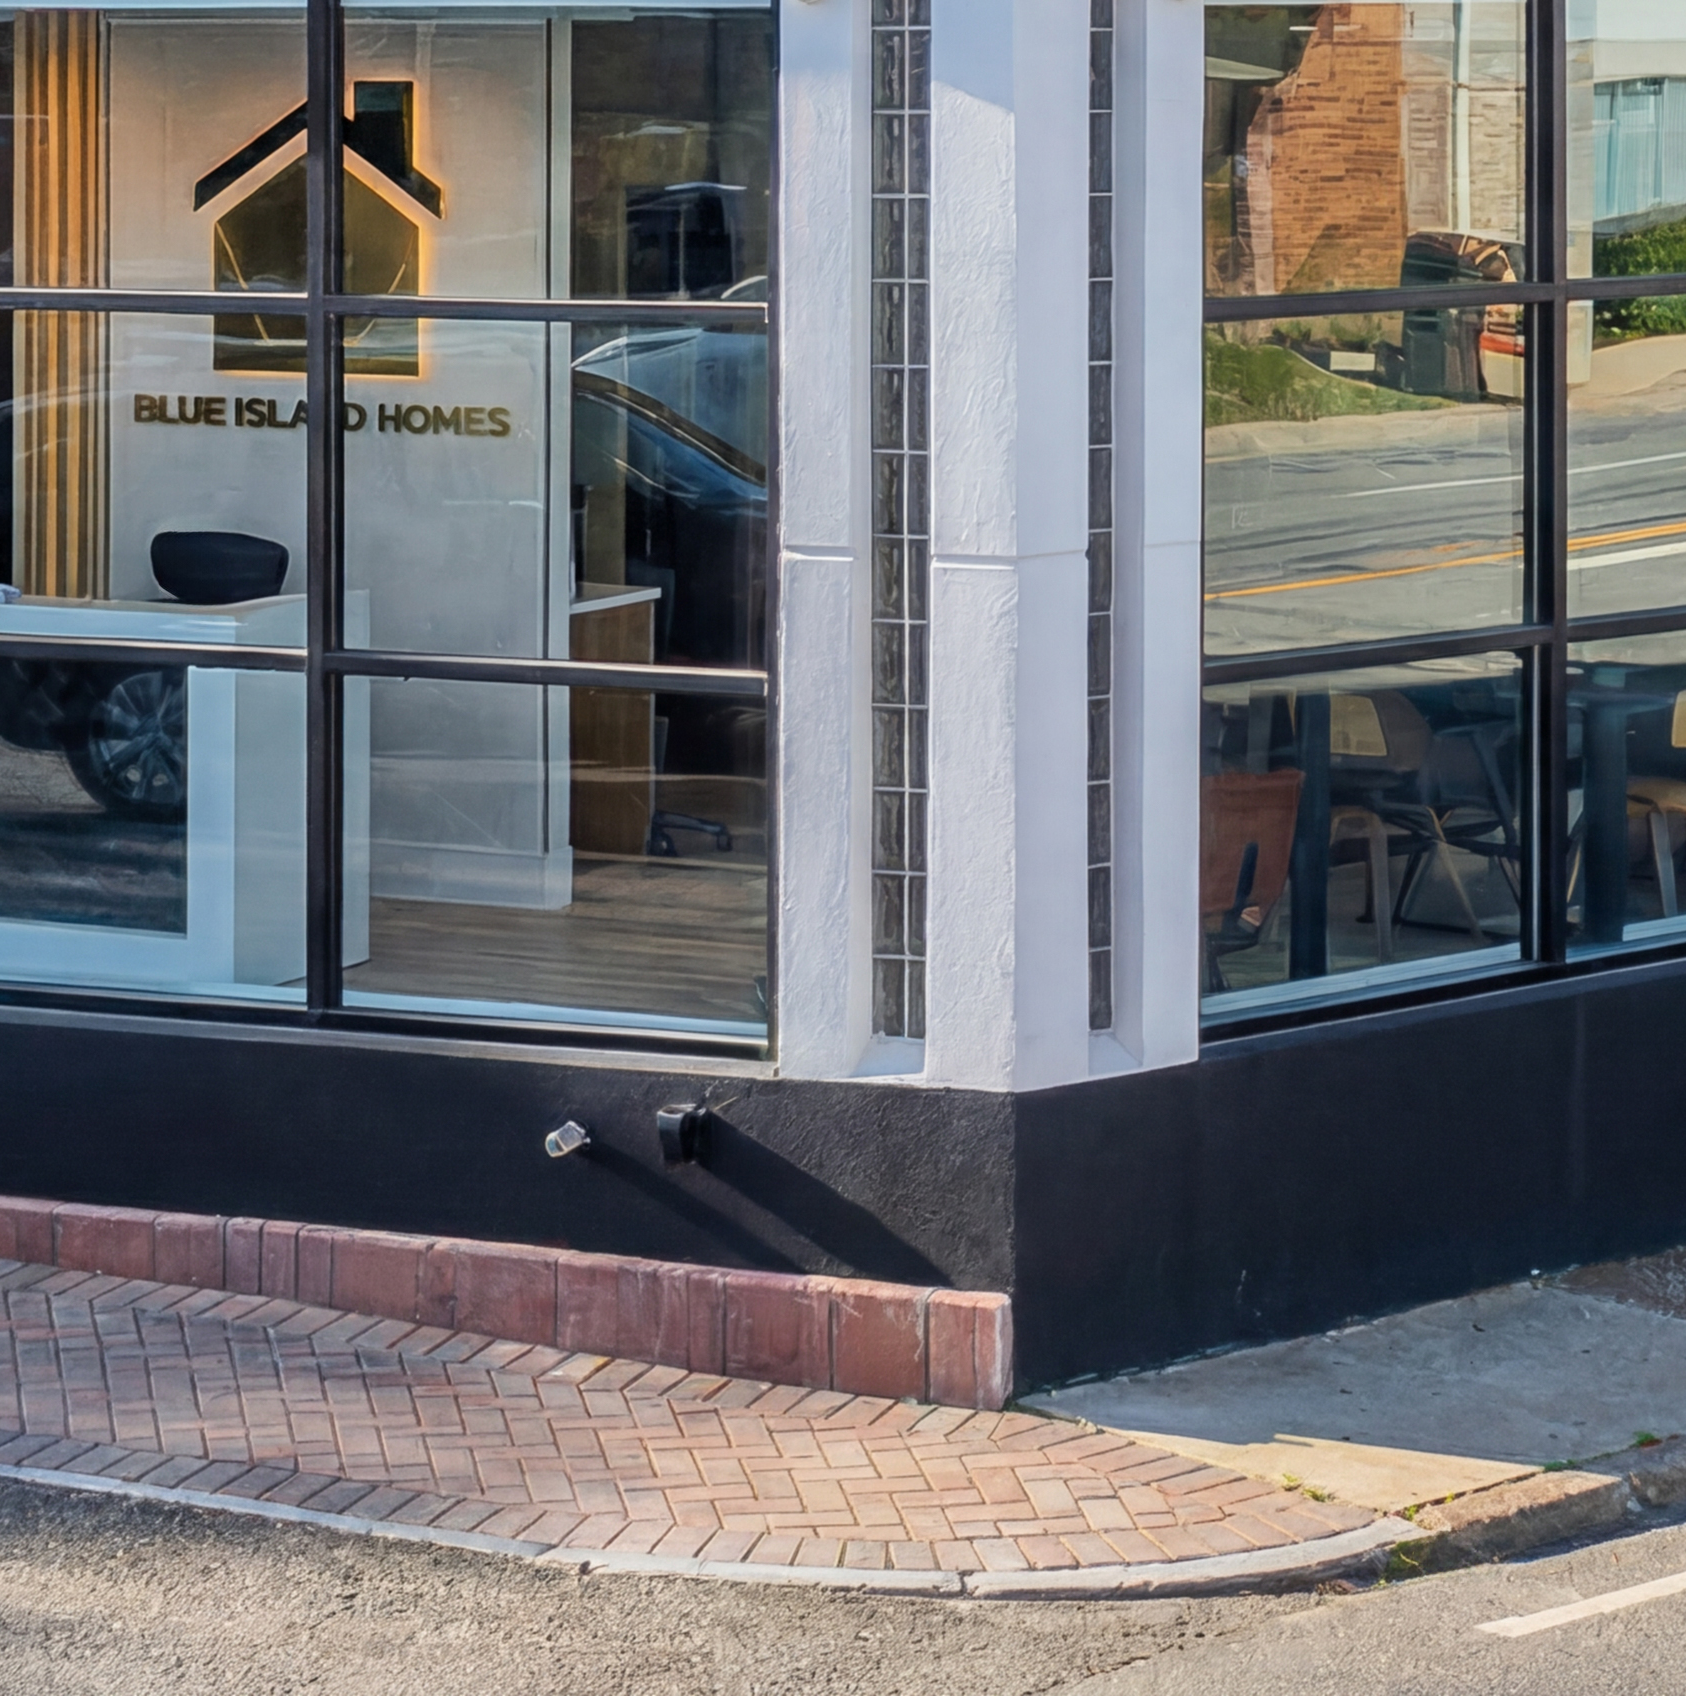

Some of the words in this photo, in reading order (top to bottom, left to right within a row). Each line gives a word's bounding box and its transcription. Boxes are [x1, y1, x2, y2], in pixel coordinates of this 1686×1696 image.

[133, 393, 227, 427] BLUE
[234, 397, 368, 432] ISLAD
[377, 403, 511, 438] HOMES
